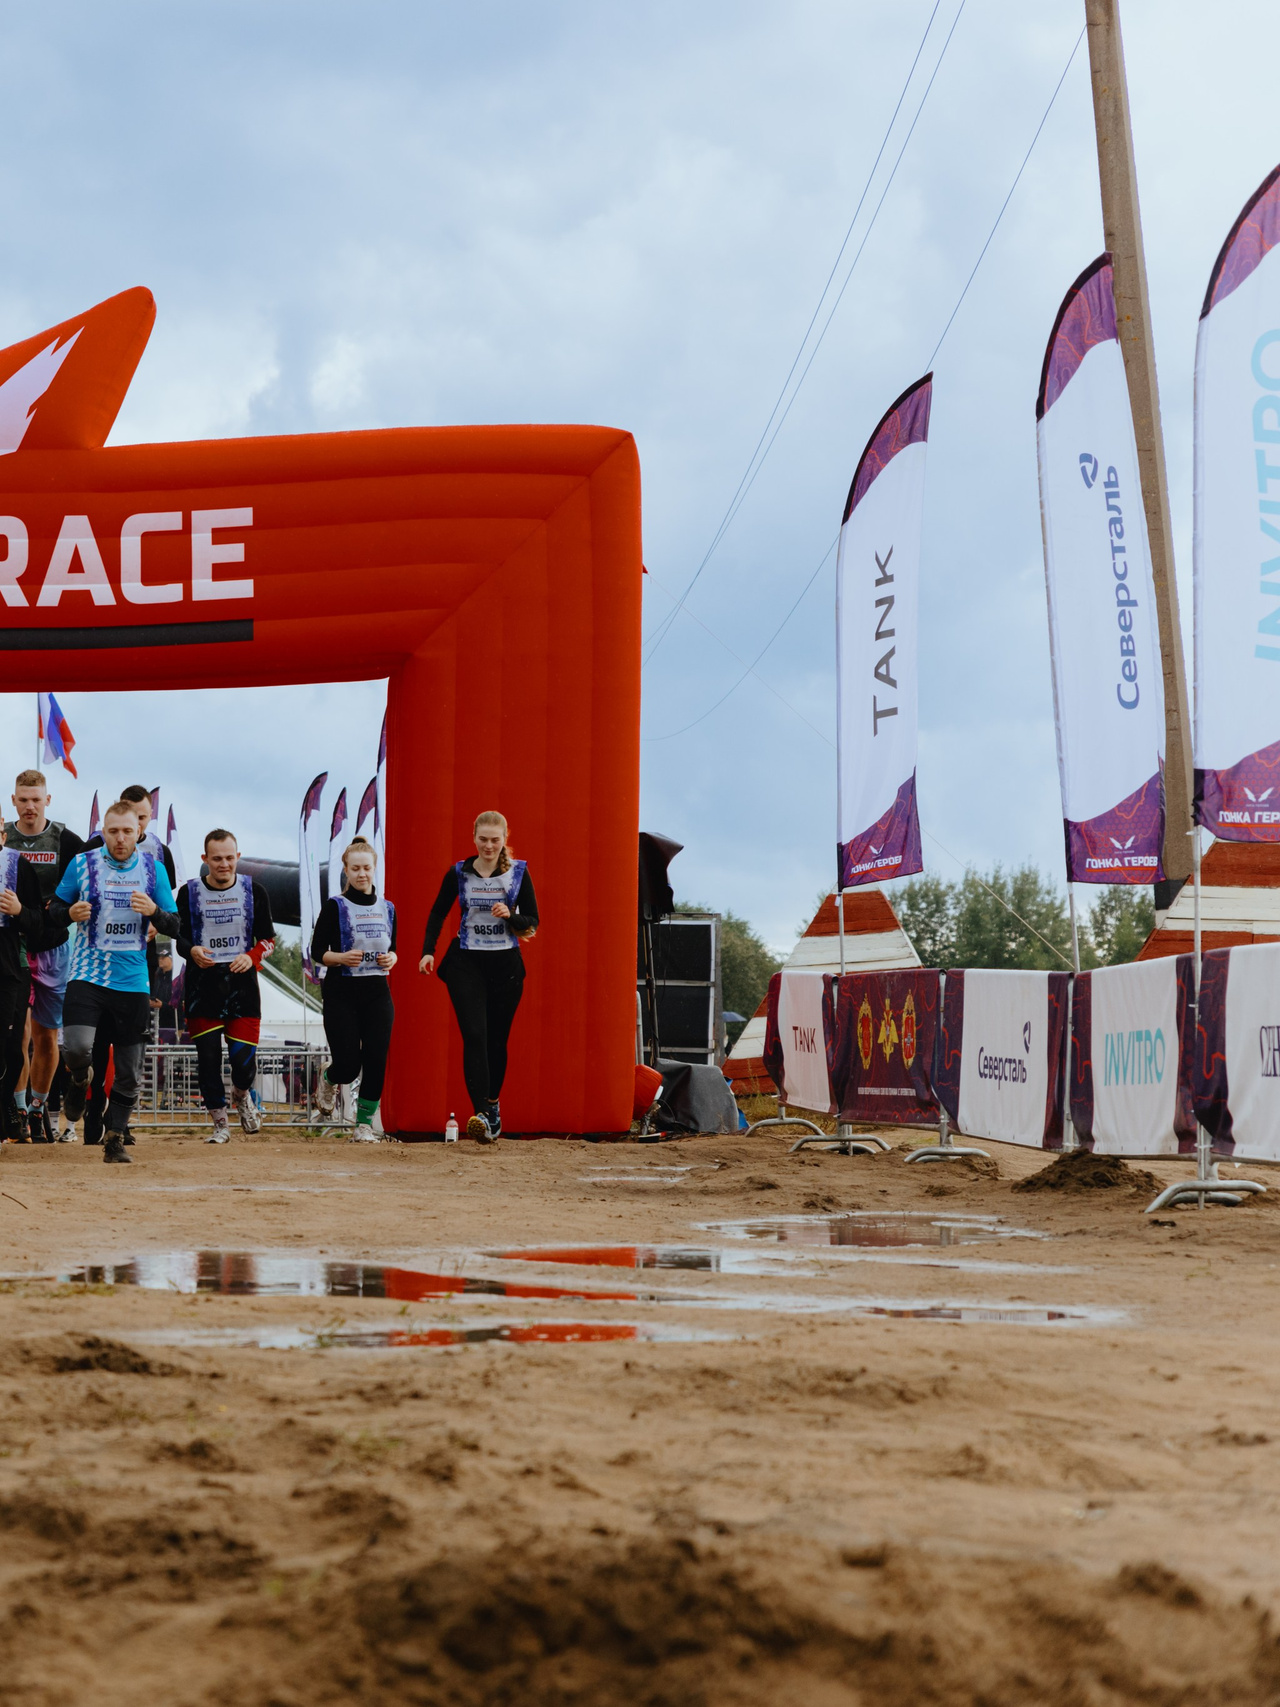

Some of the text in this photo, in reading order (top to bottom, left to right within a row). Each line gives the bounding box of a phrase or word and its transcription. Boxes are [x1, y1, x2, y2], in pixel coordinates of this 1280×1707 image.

[1103, 465, 1139, 710] Северсталь
[873, 545, 898, 736] TANK
[1219, 811, 1251, 823] ГОНКА
[1085, 856, 1159, 869] ГОНКА ГЕРОЕВ
[106, 923, 136, 935] 08501
[209, 936, 240, 948] 08507
[792, 1026, 817, 1054] TANK
[978, 1046, 1027, 1090] Северсталь
[1104, 1027, 1166, 1086] INVITRO
